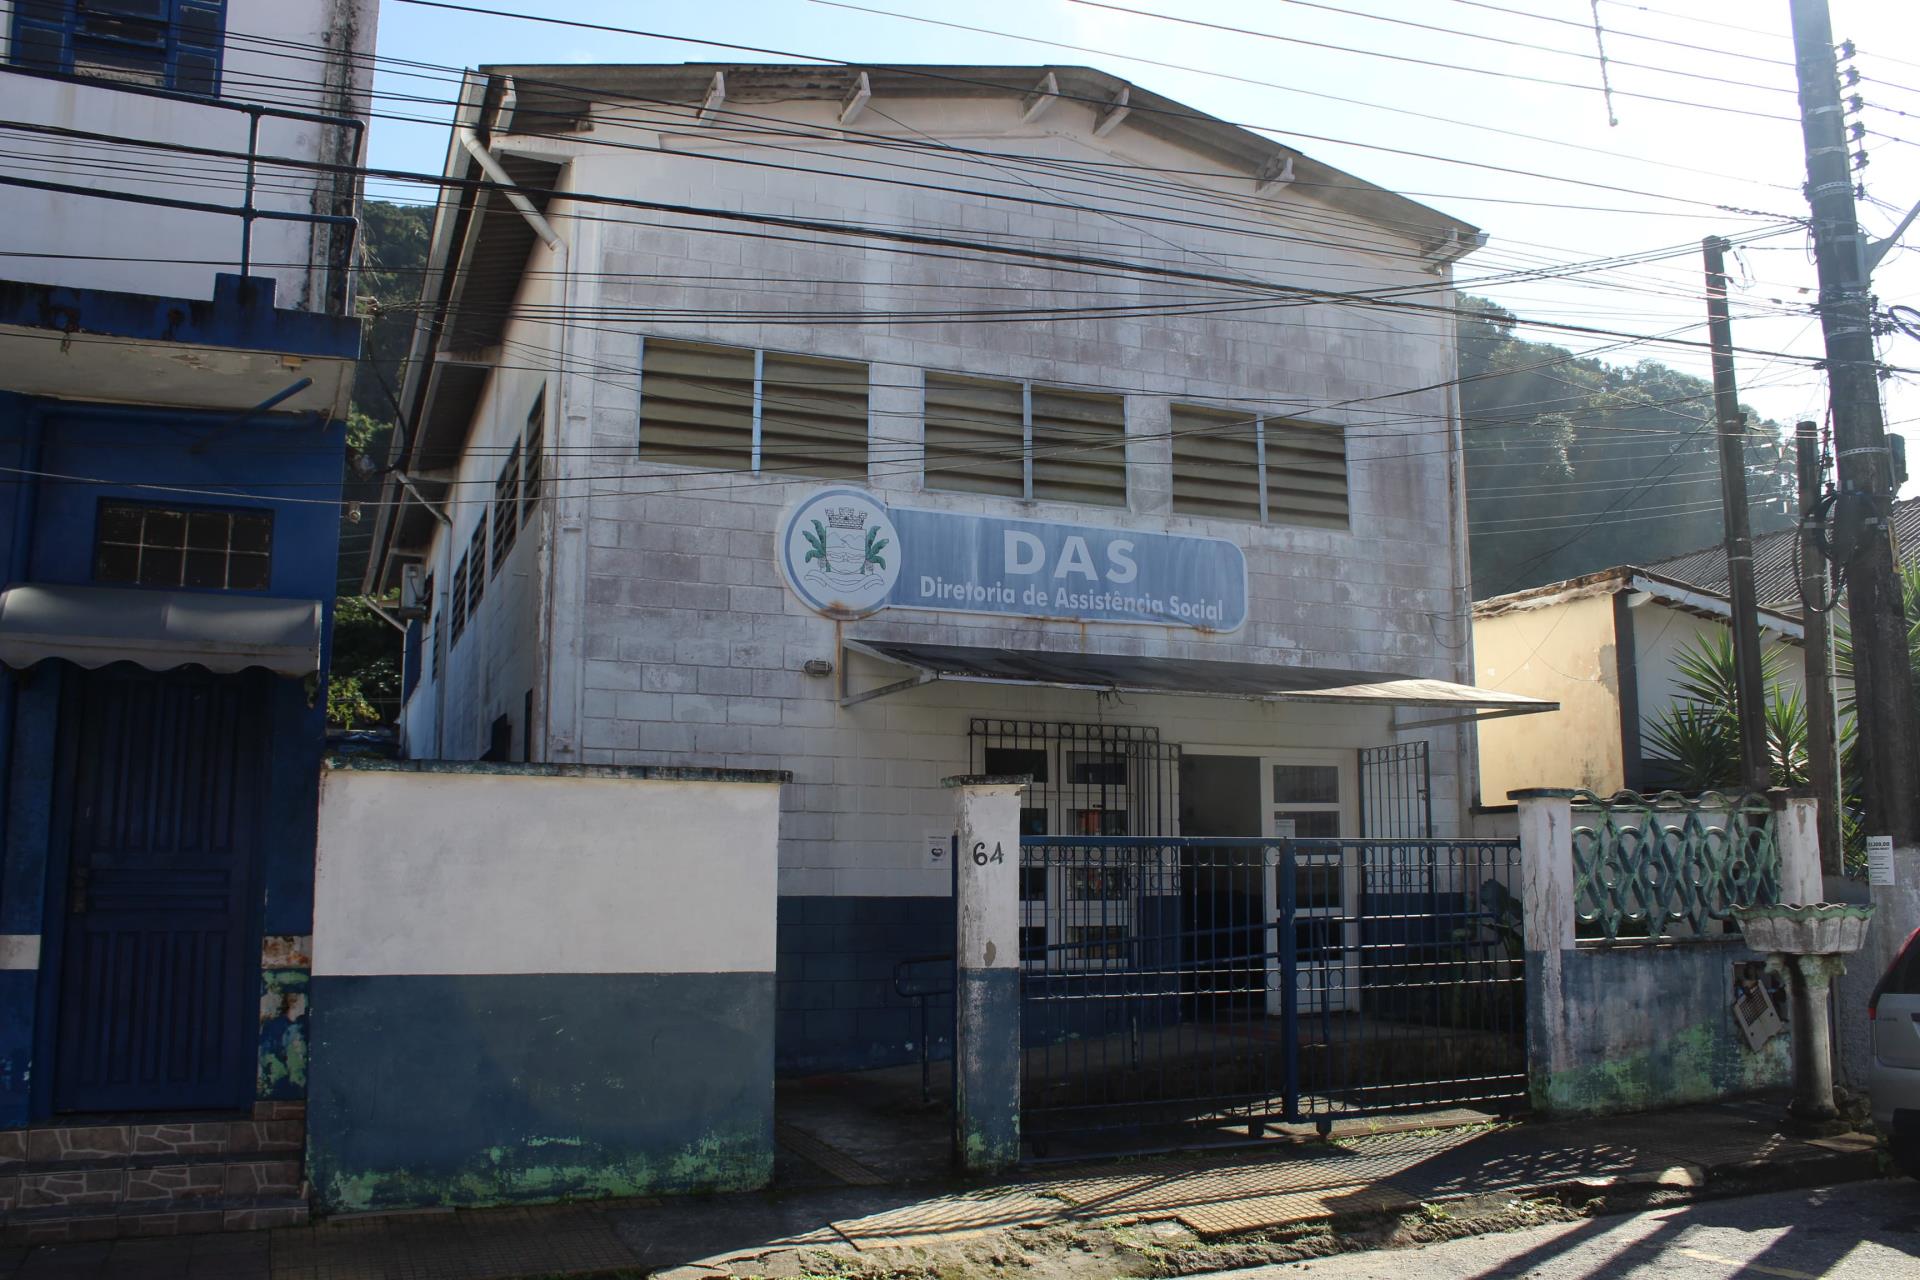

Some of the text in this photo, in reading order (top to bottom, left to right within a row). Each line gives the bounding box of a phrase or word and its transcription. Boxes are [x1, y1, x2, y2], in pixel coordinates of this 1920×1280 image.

[1003, 529, 1138, 583] DAS
[920, 575, 1224, 621] Diretoria de Assistência Social
[972, 841, 1005, 866] 64
